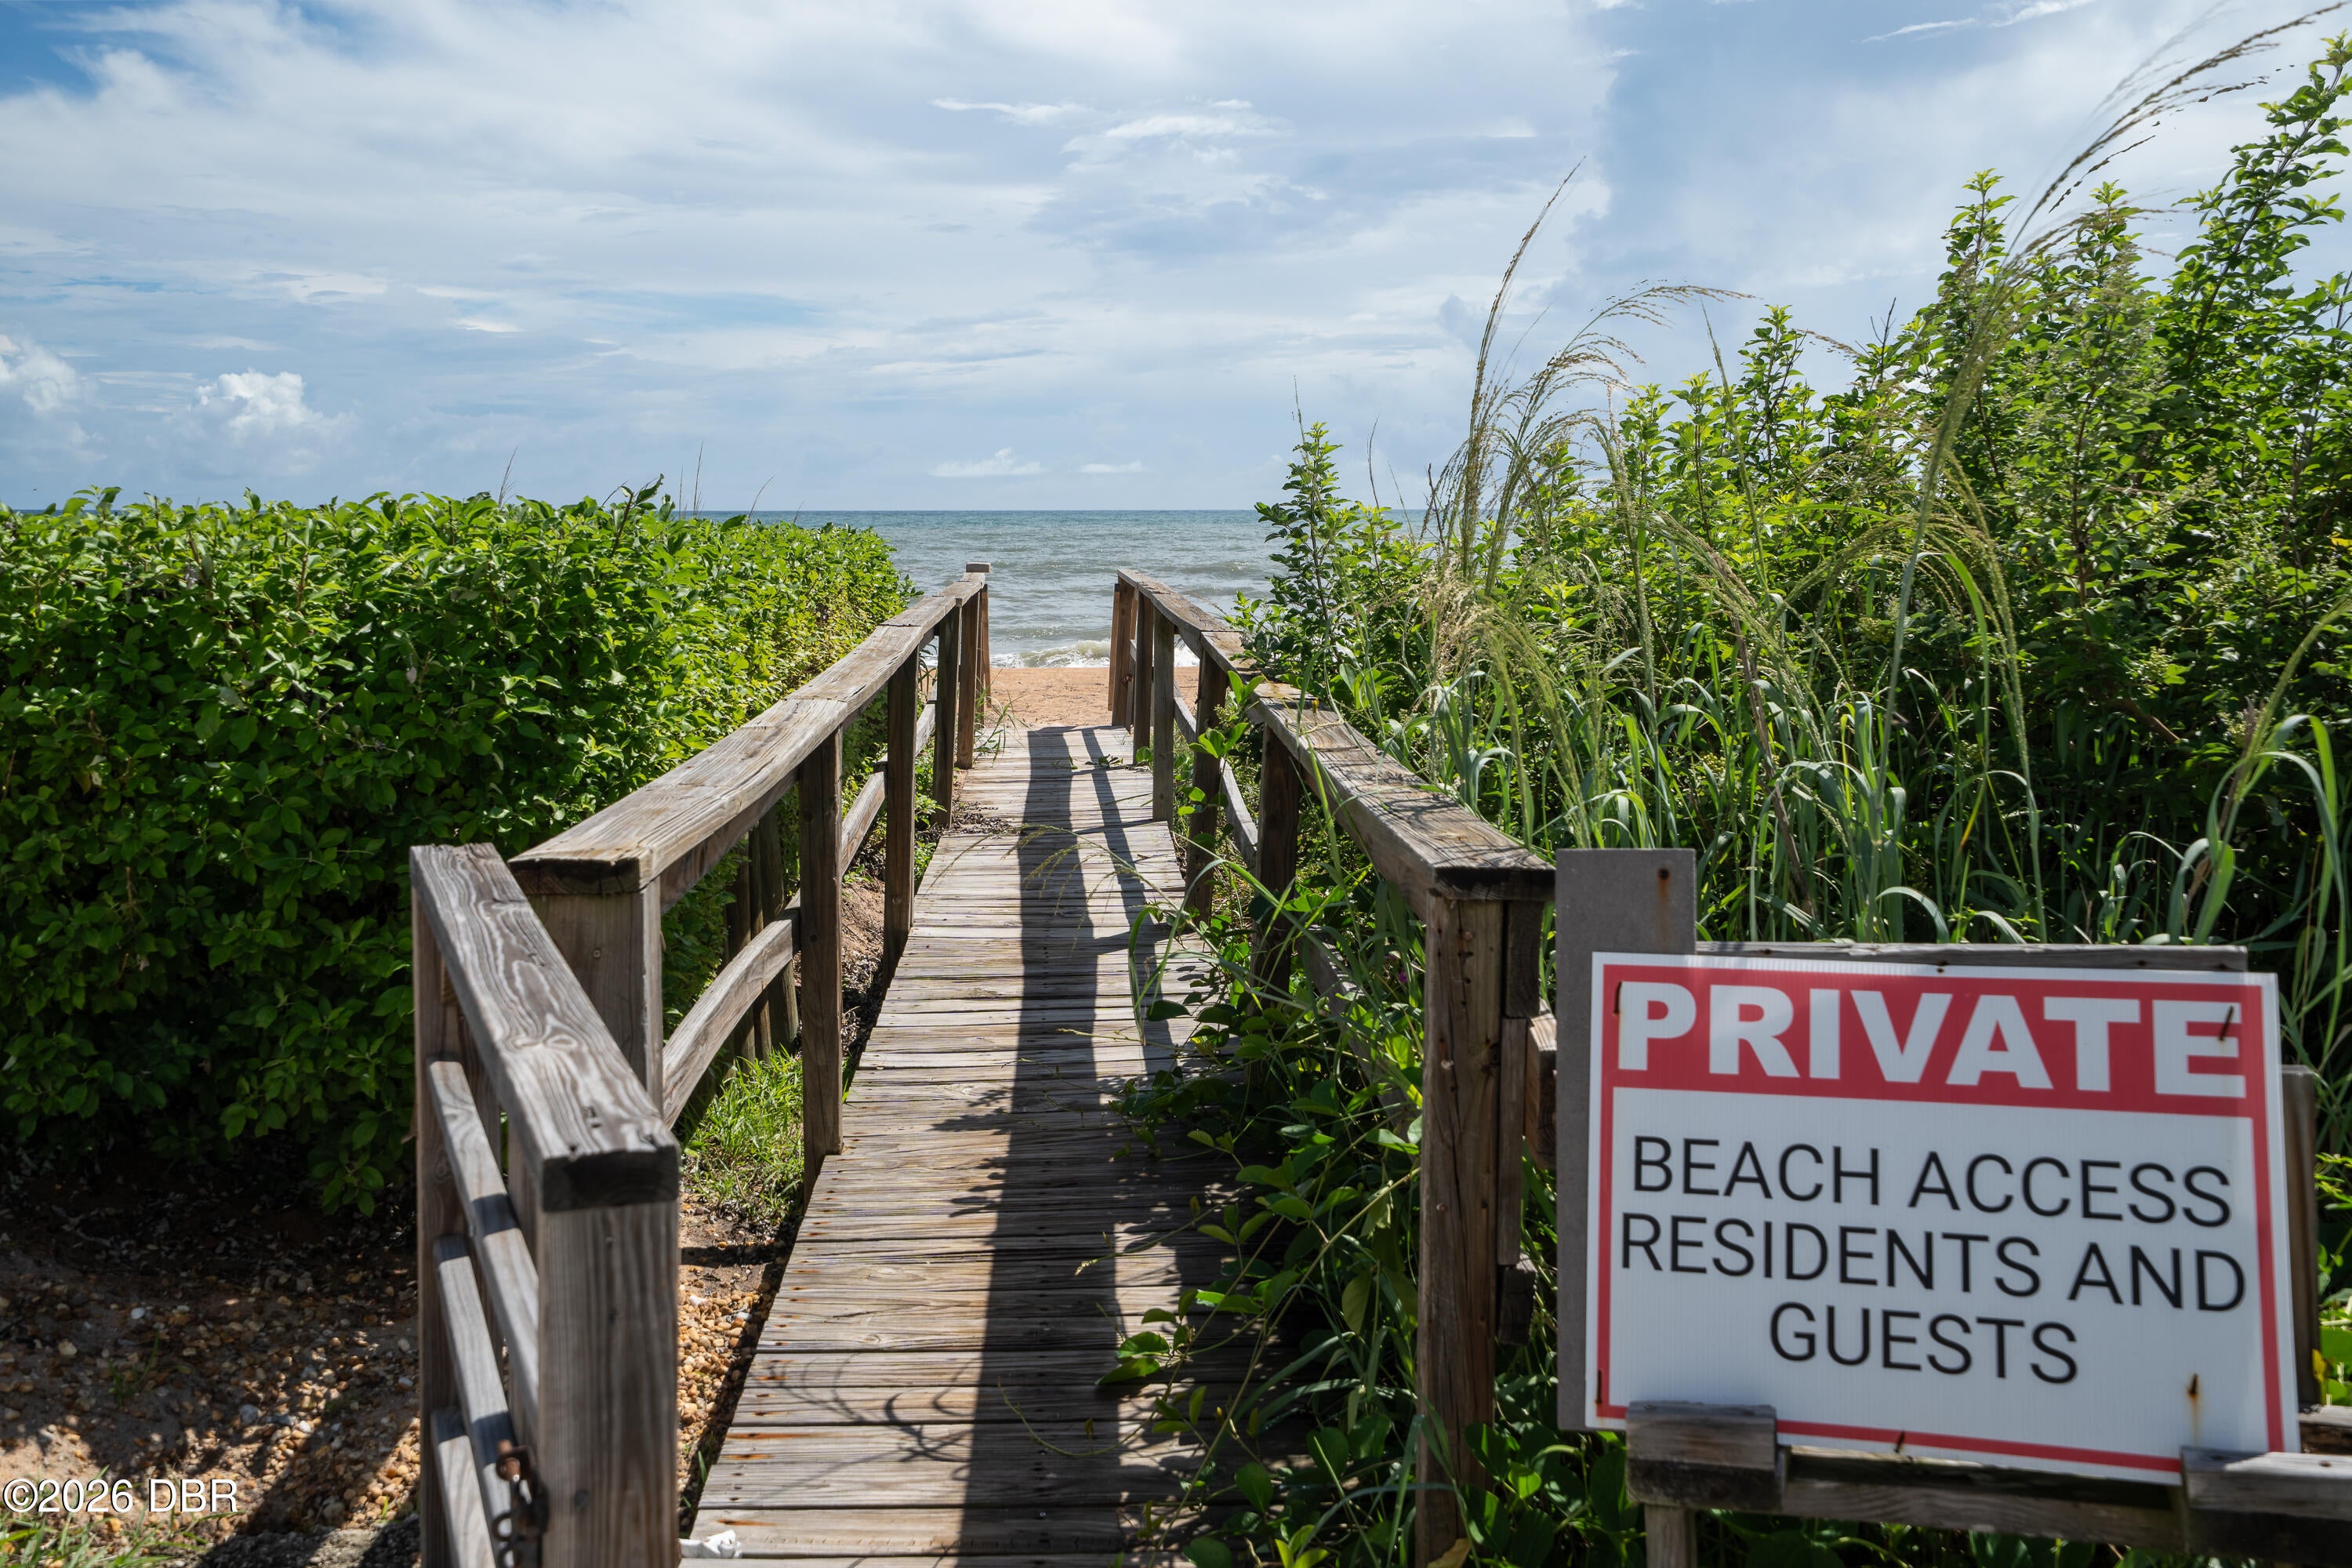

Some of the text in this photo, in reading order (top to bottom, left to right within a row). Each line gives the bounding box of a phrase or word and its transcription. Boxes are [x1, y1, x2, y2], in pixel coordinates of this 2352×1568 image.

[1617, 981, 2247, 1098] PRIVATE
[1632, 1135, 2232, 1229] BEACH ACCESS
[1621, 1212, 2246, 1312] RESIDENTS AND
[1769, 1301, 2079, 1384] GUESTS
